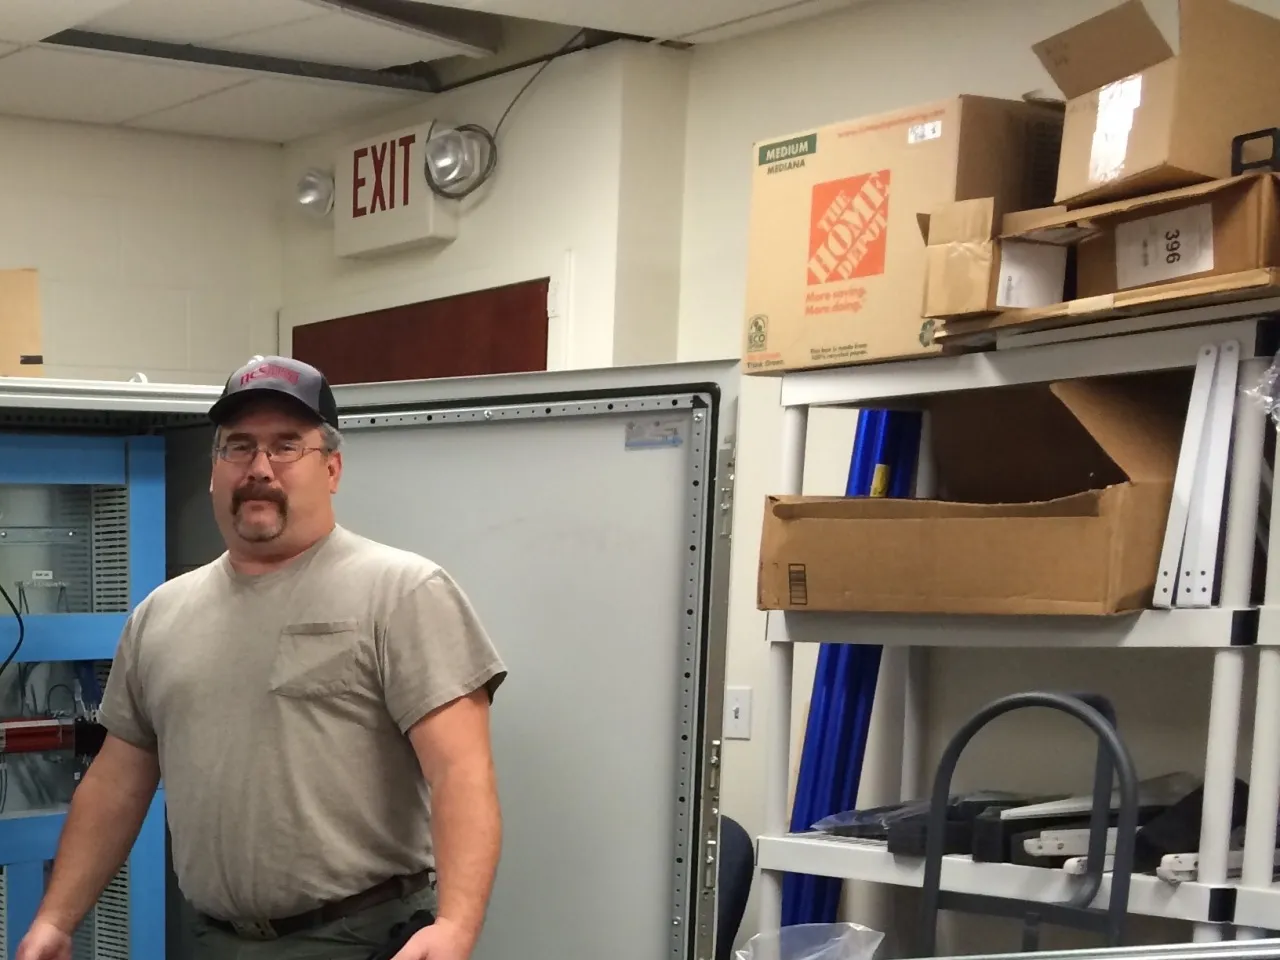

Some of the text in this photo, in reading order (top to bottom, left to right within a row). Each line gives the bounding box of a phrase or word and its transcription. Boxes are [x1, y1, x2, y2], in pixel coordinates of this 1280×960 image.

[765, 140, 809, 162] MEDIUM
[352, 133, 416, 218] EXIT
[767, 158, 806, 175] MEDIANA
[816, 189, 851, 232] THE
[807, 171, 891, 284] HOME
[836, 209, 888, 280] DEPOT
[1164, 228, 1181, 264] 396
[805, 304, 830, 316] More
[806, 290, 831, 302] More
[748, 333, 766, 344] ECO
